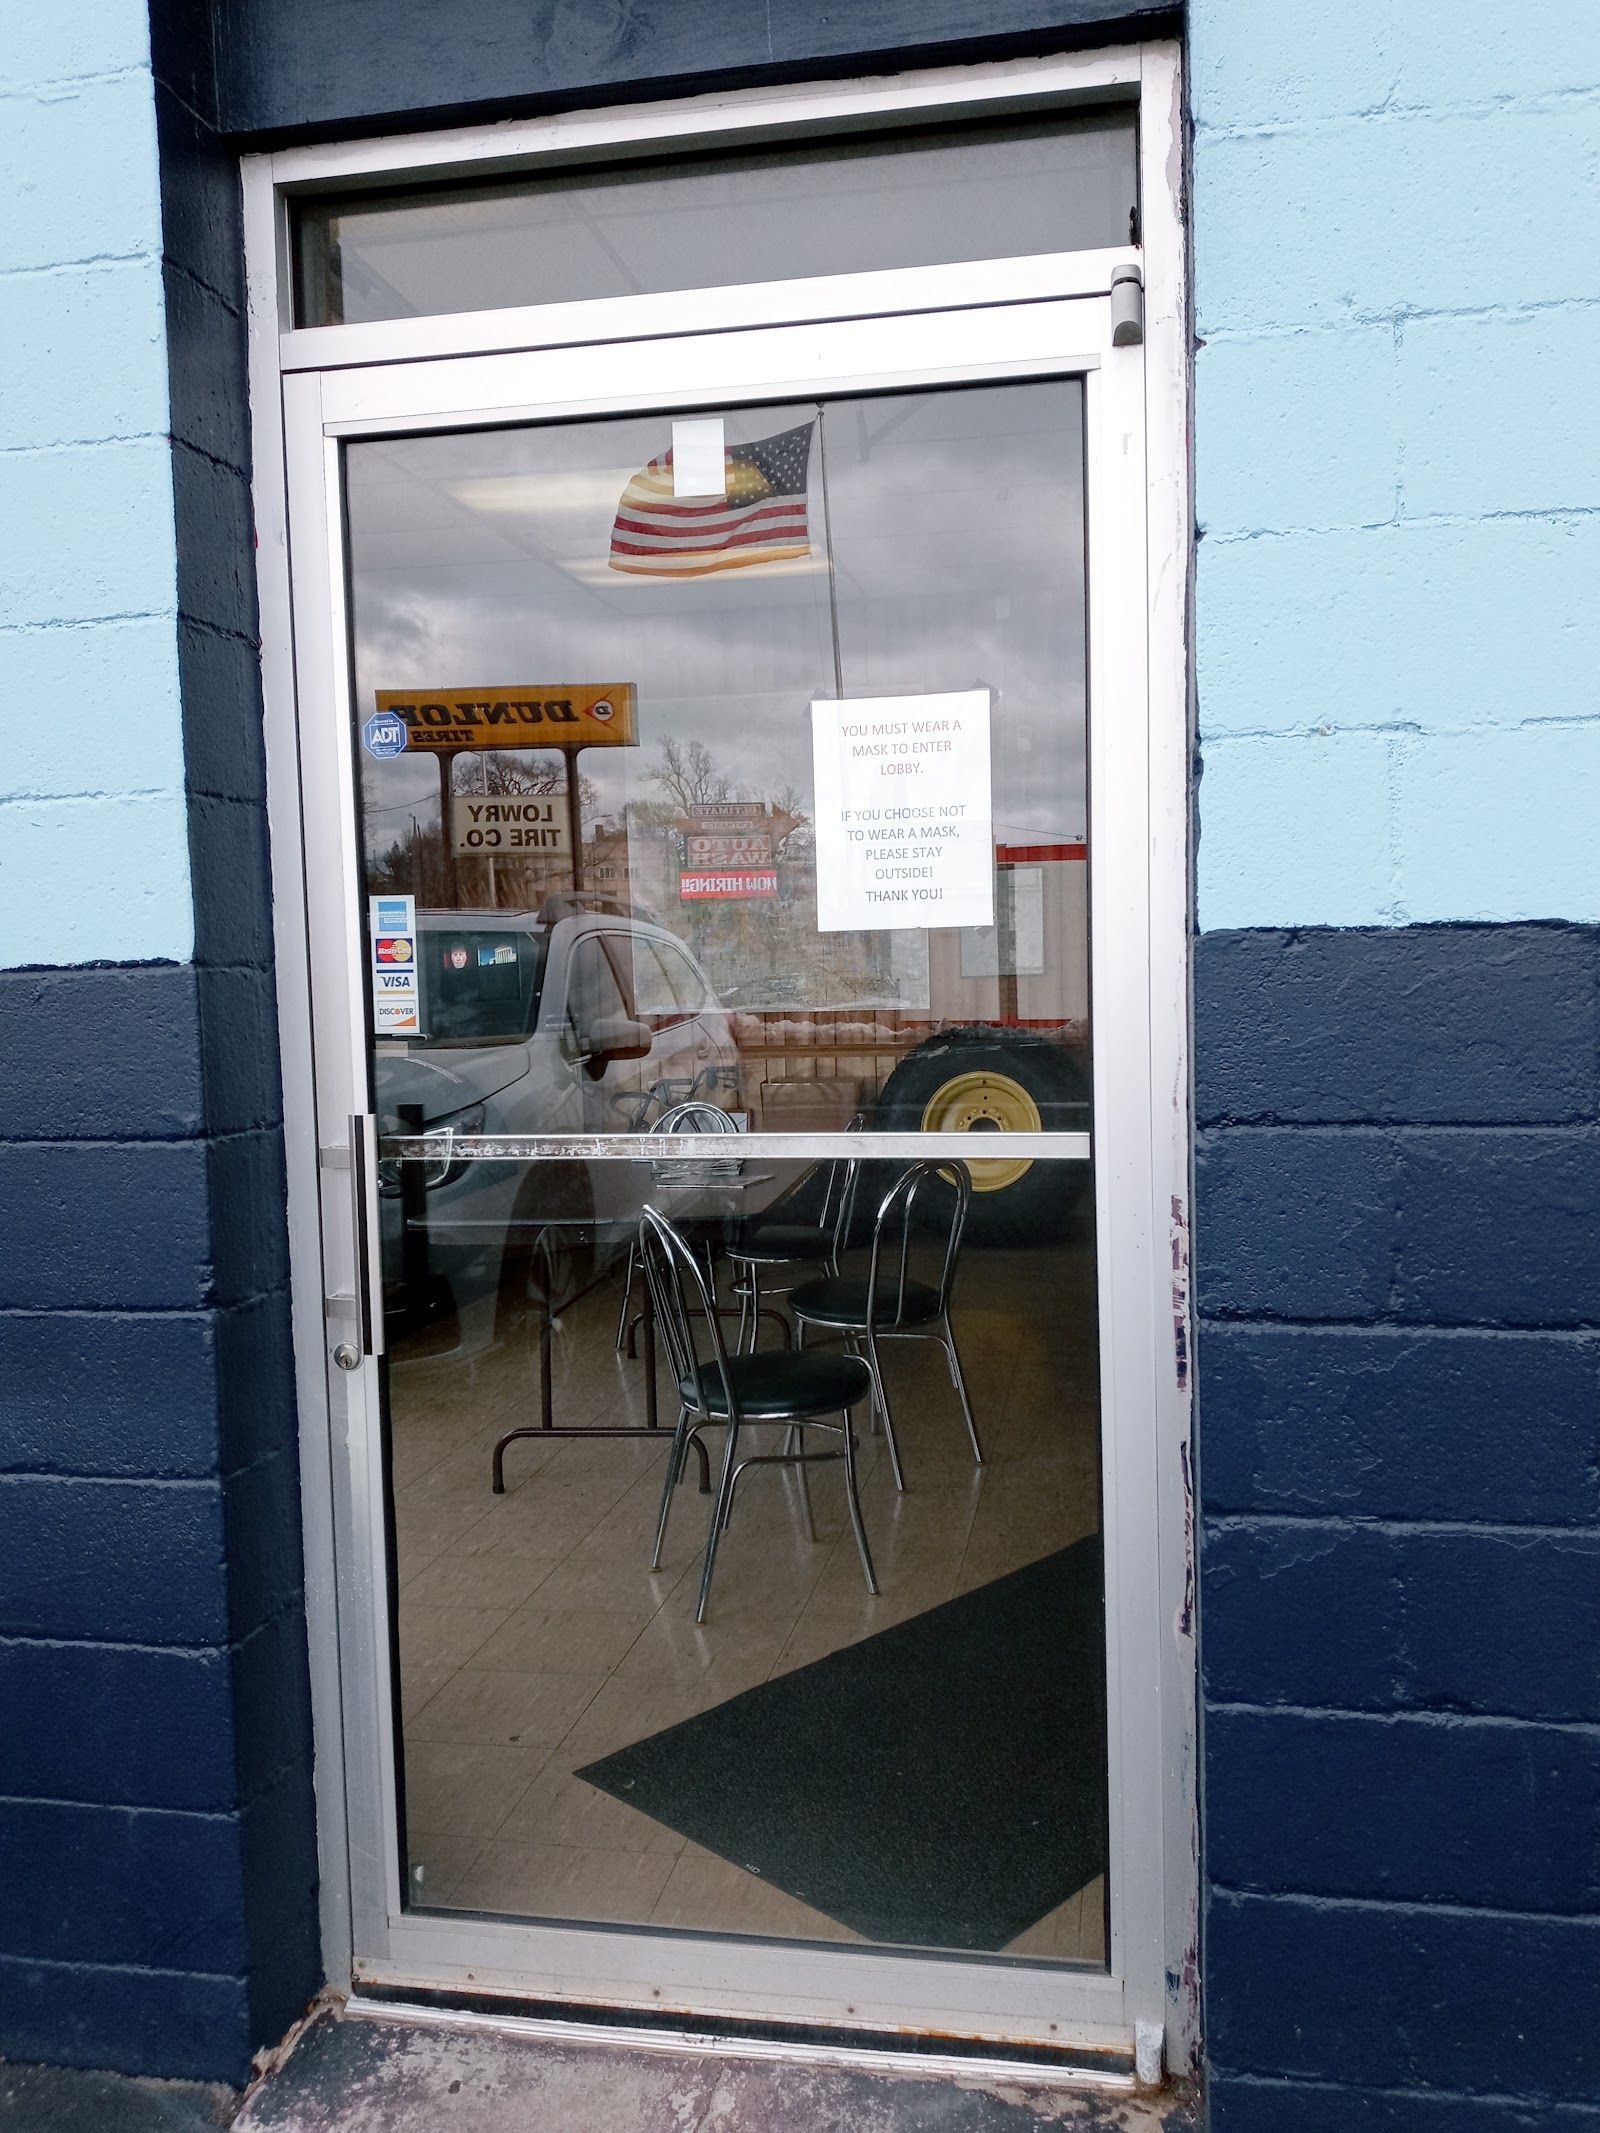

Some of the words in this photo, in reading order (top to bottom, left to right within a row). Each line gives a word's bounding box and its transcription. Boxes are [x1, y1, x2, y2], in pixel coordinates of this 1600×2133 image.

[371, 727, 399, 745] ADT
[841, 724, 868, 738] YOU
[872, 722, 908, 736] MUST
[912, 720, 949, 733] WEAR
[952, 719, 962, 731] A
[852, 743, 888, 757] MASK
[891, 742, 908, 755] TO
[912, 740, 952, 753] ENTER
[880, 762, 924, 775] LOBBY.
[841, 810, 851, 822] IF
[854, 808, 881, 821] YOU
[884, 806, 935, 820] CHOOSE
[939, 804, 967, 817] NOT
[847, 829, 865, 841] TO
[867, 827, 905, 840] WEAR
[907, 827, 917, 838] A
[920, 825, 960, 839] MASK,
[866, 847, 909, 861] PLEASE
[912, 846, 943, 858] STAY
[875, 866, 933, 880] OUTSIDE!
[866, 889, 908, 902] THANK
[912, 888, 943, 900] YOU!
[381, 976, 410, 988] VISA
[379, 1007, 414, 1016] DISCOVER
